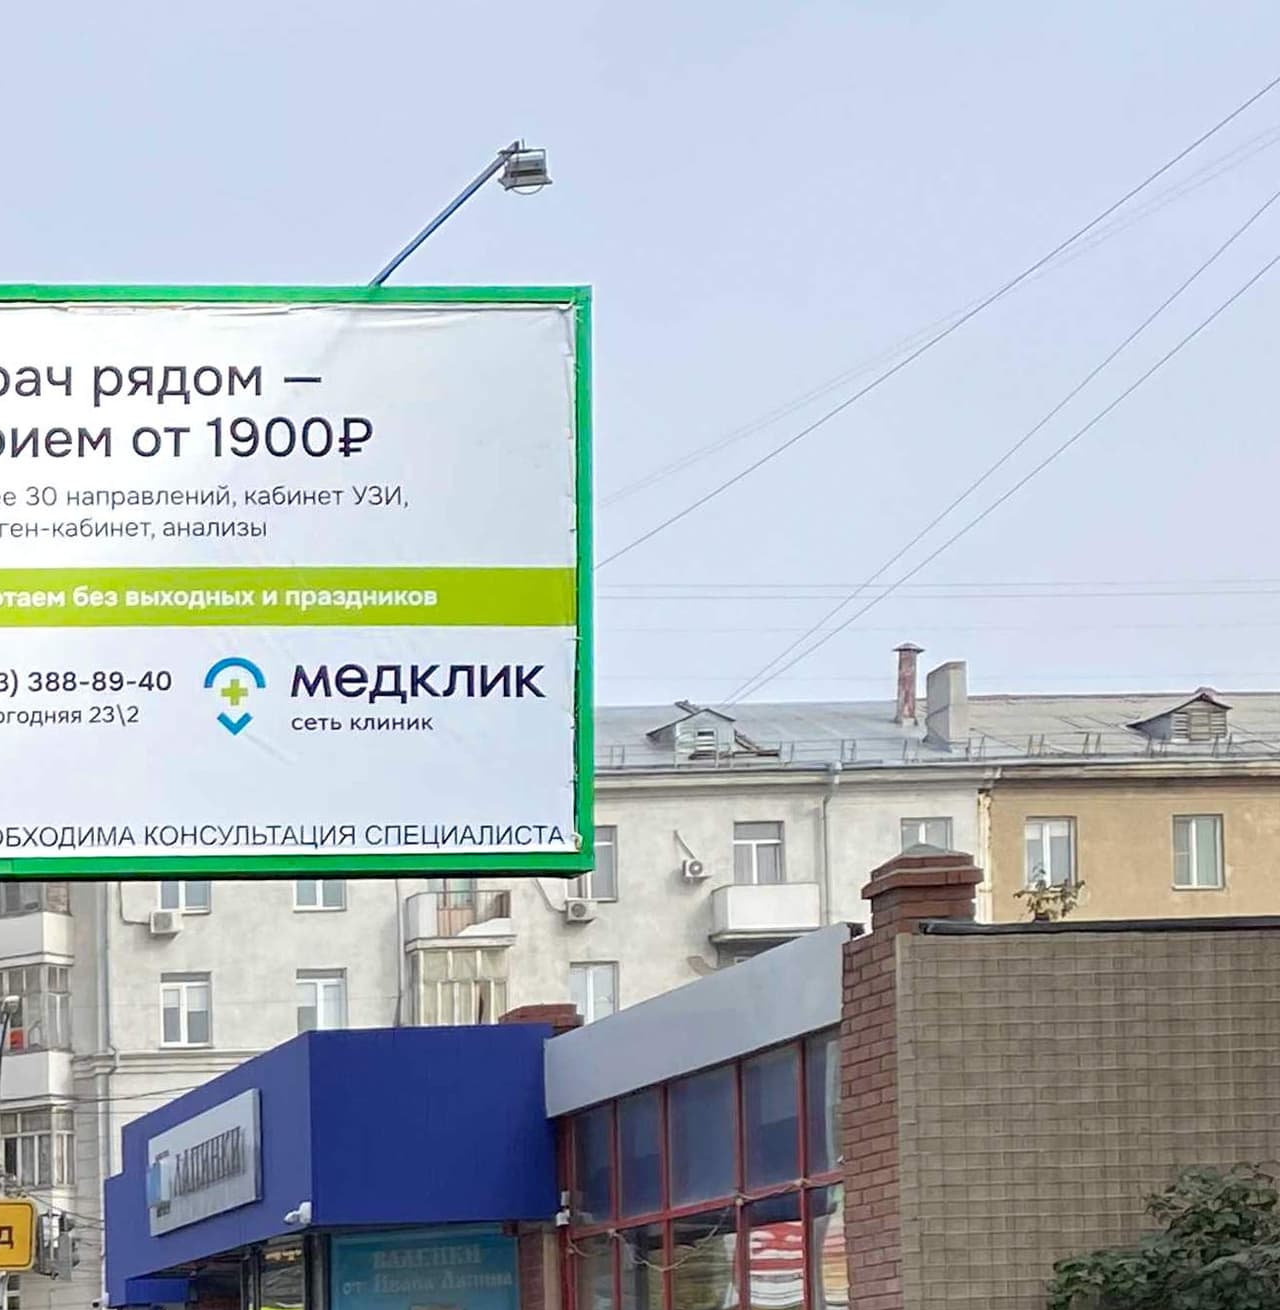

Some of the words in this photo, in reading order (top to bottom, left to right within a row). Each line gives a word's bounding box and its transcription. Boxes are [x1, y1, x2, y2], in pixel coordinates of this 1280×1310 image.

[93, 365, 263, 408] рядом
[132, 426, 191, 458] от
[206, 416, 374, 458] 1900₽
[26, 486, 57, 506] 30
[67, 484, 238, 511] направлений,
[244, 484, 344, 506] кабинет
[352, 485, 410, 511] УЗИ,
[162, 521, 268, 538] анализы
[72, 586, 118, 607] без
[126, 590, 255, 609] выходных
[261, 590, 278, 606] и
[285, 588, 438, 610] праздников
[27, 670, 173, 693] 388-89-40
[290, 663, 547, 705] медклик
[88, 704, 140, 727] 23\2
[291, 716, 343, 732] сеть
[350, 716, 435, 731] клиник
[144, 824, 357, 849] КОНСУЛЬТАЦИЯ
[365, 823, 566, 849] СПЕЦИАЛИСТА
